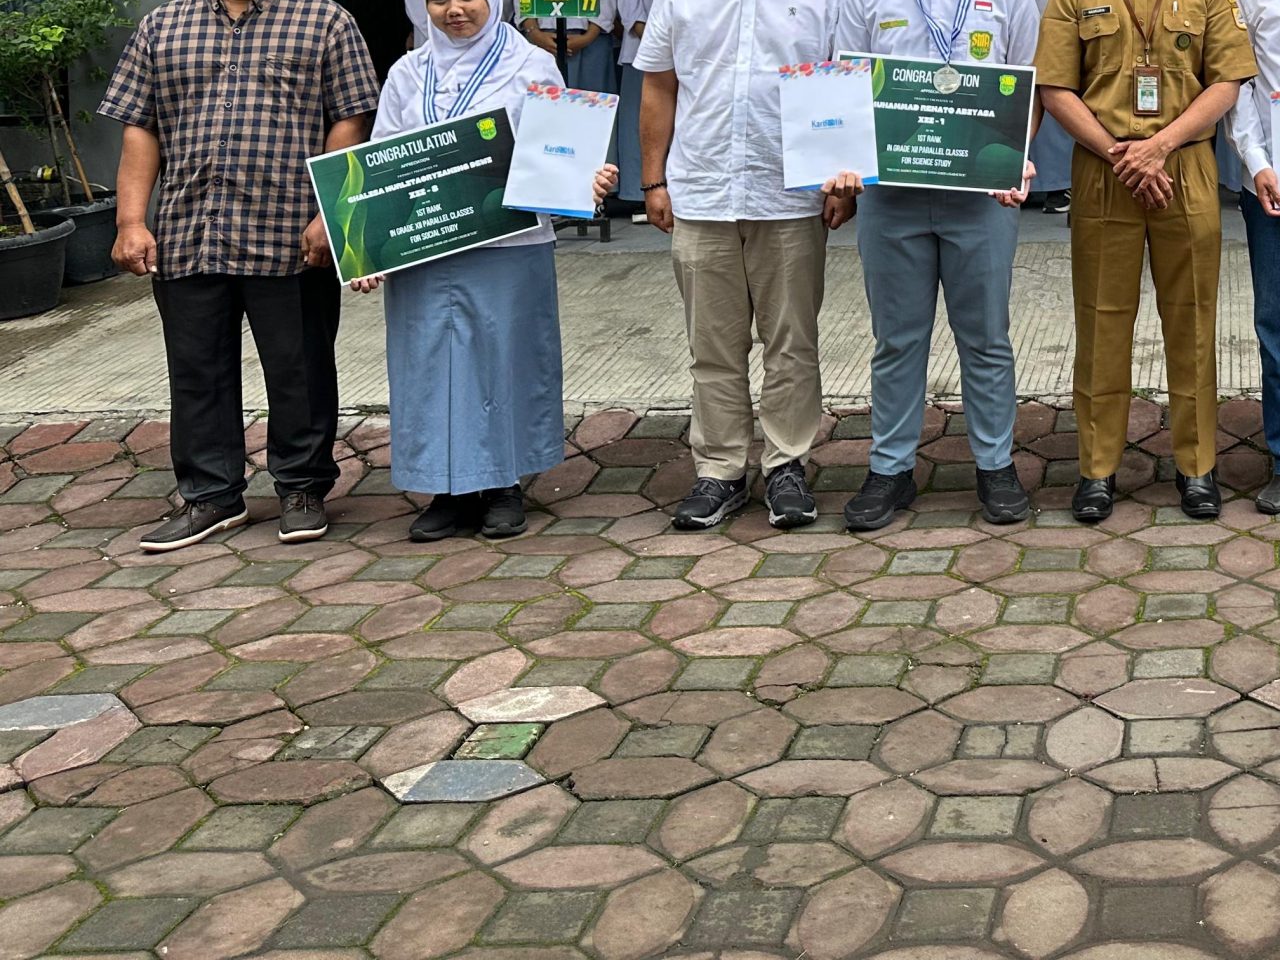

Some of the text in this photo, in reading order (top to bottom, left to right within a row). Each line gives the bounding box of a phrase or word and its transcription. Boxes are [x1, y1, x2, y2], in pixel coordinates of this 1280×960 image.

[550, 2, 564, 16] X
[972, 32, 990, 47] SMA
[892, 68, 980, 88] CONGRATION
[927, 135, 941, 143] RANK
[364, 129, 458, 168] CONGRATULATION
[918, 147, 944, 155] PARALLEL
[945, 149, 969, 157] CLASSES
[912, 158, 934, 166] SCIENCE
[935, 159, 951, 167] STUDY
[416, 203, 443, 217] 1ST RANK
[389, 229, 397, 237] IN
[396, 224, 415, 235] GRADE
[422, 214, 450, 228] PARALLEL
[449, 206, 475, 220] CLASSES
[409, 234, 421, 244] FOR
[421, 229, 440, 240] SOCIAL
[440, 223, 459, 235] STUDY
